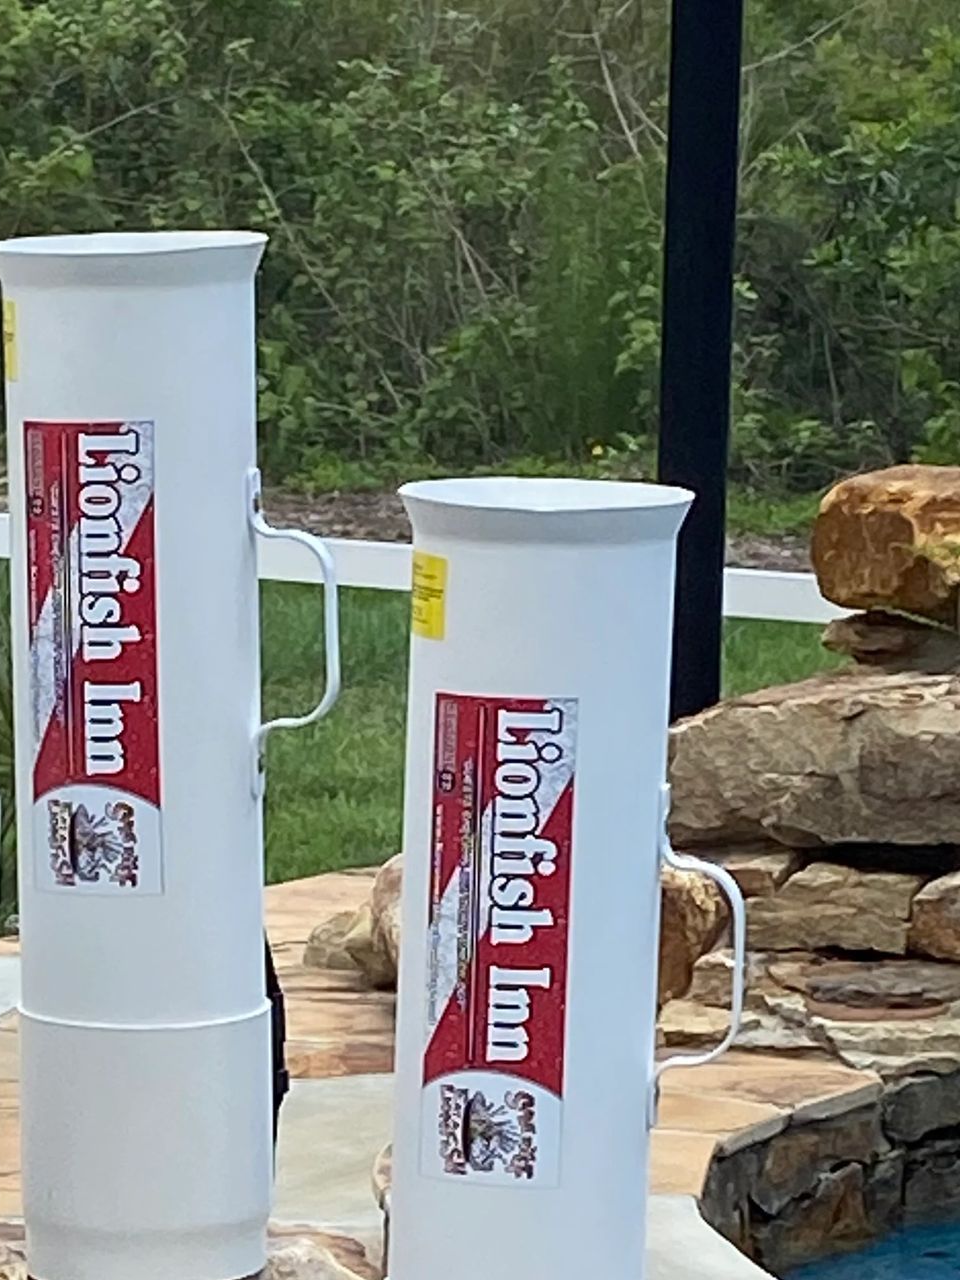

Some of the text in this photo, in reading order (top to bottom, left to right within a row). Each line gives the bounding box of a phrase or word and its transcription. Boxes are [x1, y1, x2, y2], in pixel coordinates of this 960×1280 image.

[79, 431, 141, 776] Lionfish Inn
[485, 707, 562, 1063] Lionfish Inn
